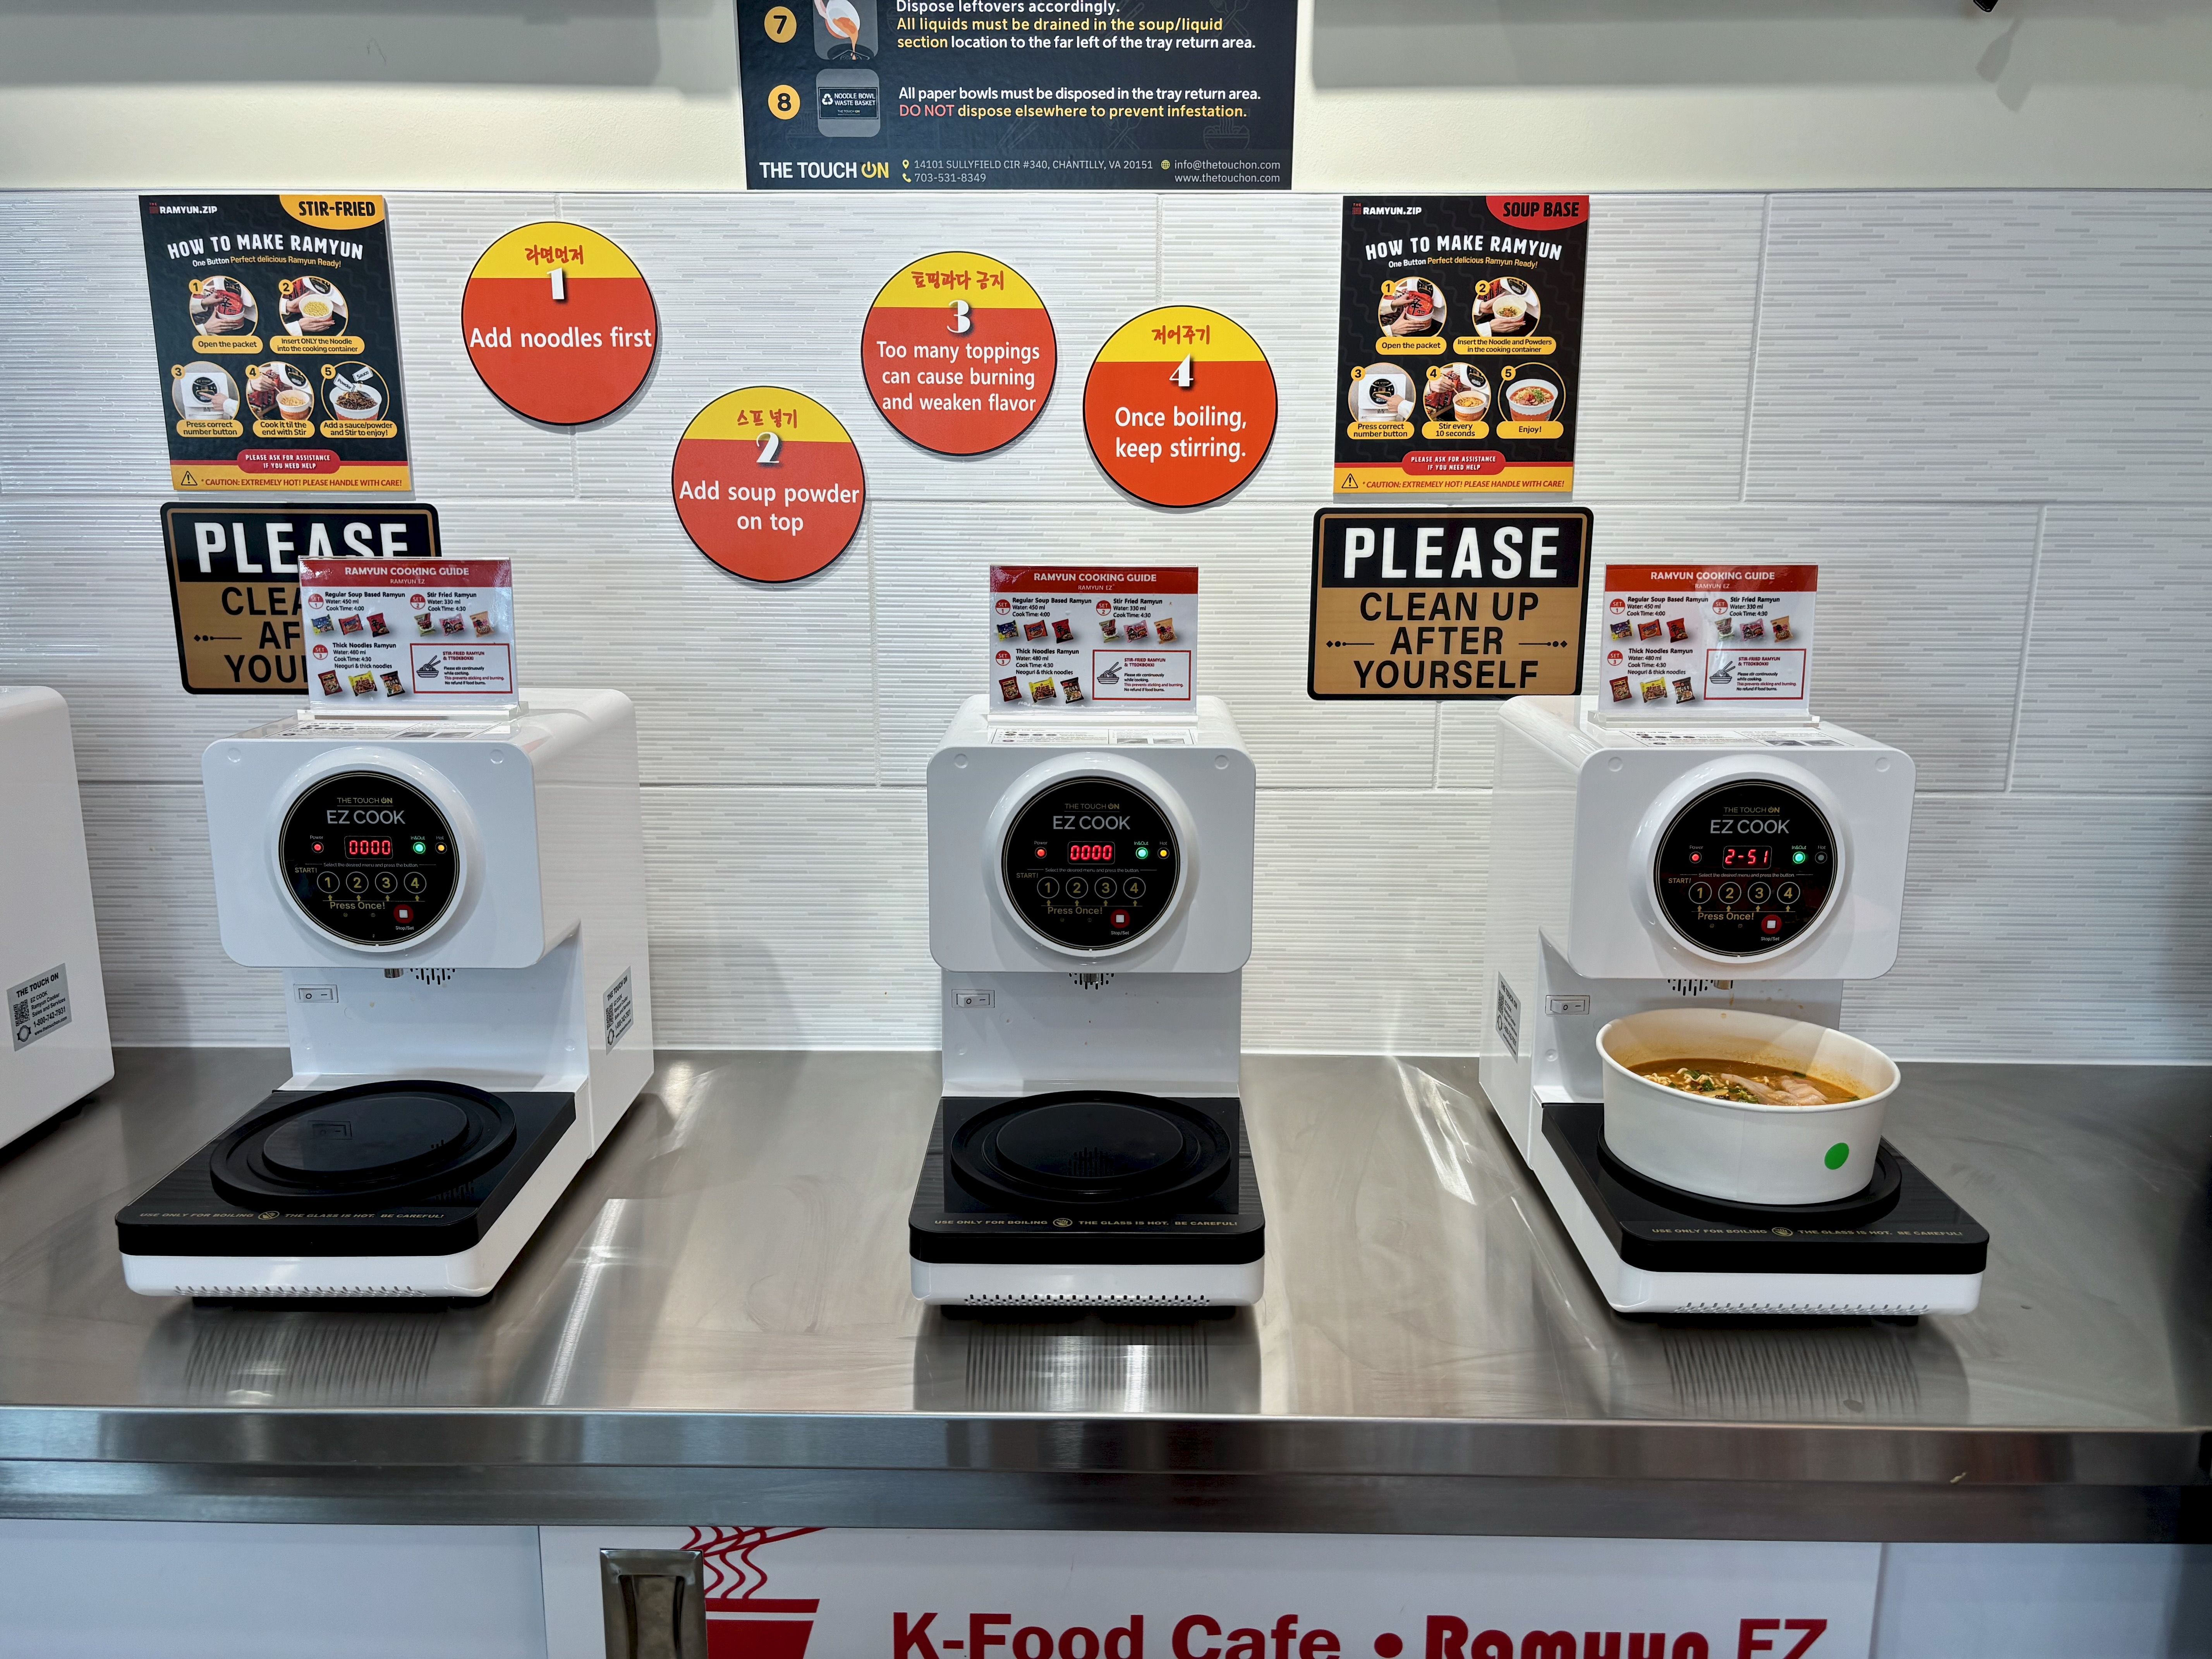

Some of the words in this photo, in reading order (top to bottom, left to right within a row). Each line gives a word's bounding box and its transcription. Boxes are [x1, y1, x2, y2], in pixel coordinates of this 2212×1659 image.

[896, 0, 954, 15] Dispose
[959, 0, 1024, 12] leftovers
[1029, 0, 1120, 15] accordingly.
[773, 15, 787, 34] 7
[897, 17, 915, 30] All
[920, 17, 968, 33] liquids
[972, 19, 1008, 30] must
[1012, 17, 1029, 30] be
[1034, 18, 1089, 30] drained
[1094, 18, 1106, 30] in
[1110, 18, 1135, 30] the
[1139, 17, 1222, 33] soup/liquid
[898, 35, 948, 48] section
[951, 35, 1007, 48] location
[1010, 36, 1025, 48] to
[1028, 36, 1051, 48] the
[1054, 36, 1073, 48] far
[1077, 36, 1100, 48] left
[1103, 36, 1118, 48] of
[1120, 36, 1142, 48] the
[1145, 36, 1173, 52] tray
[1176, 36, 1219, 48] return
[1221, 38, 1256, 49] area.
[777, 93, 792, 112] 8
[900, 104, 921, 116] DO
[925, 105, 955, 117] NOT
[958, 105, 1012, 119] dispose
[1015, 105, 1087, 117] elsewhere
[1090, 105, 1106, 117] to
[1109, 105, 1164, 120] prevent
[1168, 105, 1247, 117] infestation.
[759, 162, 793, 178] THE
[797, 162, 857, 179] TOUCH
[914, 160, 944, 169] 14101
[946, 160, 1001, 169] SULLYFIELD
[1003, 160, 1020, 169] CIR
[1022, 160, 1050, 170] #340,
[1052, 160, 1106, 170] CHANTILLY,
[1108, 160, 1121, 169] VA
[1123, 160, 1153, 169] 20151
[1175, 160, 1280, 170] info@thetouchon.com
[914, 173, 986, 183] 703-531-8349
[1174, 172, 1280, 183] www.thetouchon.com
[159, 205, 218, 214] RAMYUN.ZIP
[299, 201, 375, 216] STIR-FRIED
[1363, 206, 1422, 215] RAMYUN.ZIP
[1503, 202, 1540, 217] SOUP
[1543, 202, 1580, 217] BASE
[167, 238, 204, 259] HOW
[210, 235, 231, 252] TO
[237, 234, 283, 250] MAKE
[290, 235, 363, 260] RAMYUN
[524, 244, 584, 266] 라면먼저
[1365, 239, 1403, 261] HOW
[1410, 237, 1430, 253] TO
[1437, 235, 1484, 251] MAKE
[1490, 236, 1562, 261] RAMYUN
[548, 268, 564, 299] 1
[976, 270, 1004, 290] 금지
[947, 300, 970, 333] 3
[470, 327, 512, 348] Add
[521, 326, 602, 347] noodles
[610, 326, 652, 347] first
[1151, 325, 1210, 345] 저어주기
[876, 341, 907, 358] Too
[914, 345, 959, 364] many
[965, 342, 1040, 364] toppings
[1381, 342, 1401, 350] Open
[1415, 342, 1441, 350] packet
[882, 371, 910, 384] can
[917, 372, 963, 385] cause
[970, 367, 1034, 390] burning
[1169, 355, 1194, 387] 4
[882, 392, 913, 410] and
[919, 393, 981, 410] weaken
[988, 393, 1036, 411] flavor
[737, 410, 764, 426] 스프
[769, 408, 797, 429] 넣기
[1115, 407, 1165, 427] Once
[1174, 405, 1246, 432] boiling,
[1518, 425, 1542, 434] Enjoy!
[756, 432, 780, 463] 2
[1116, 437, 1162, 463] keep
[1170, 436, 1246, 463] stirring.
[679, 480, 720, 500] Add
[728, 486, 776, 507] soup
[785, 483, 860, 507] powder
[737, 516, 762, 530] on
[769, 514, 804, 536] top
[1344, 526, 1559, 579] PLEASE
[1034, 573, 1076, 581] RAMYUN
[1078, 573, 1125, 582] COOKING
[1126, 573, 1157, 582] GUIDE
[1650, 572, 1694, 580] RAMYUN
[1696, 571, 1742, 580] COOKING
[1744, 572, 1775, 580] GUIDE
[1360, 592, 1477, 621] CLEAN
[1492, 592, 1539, 621] UP
[1390, 627, 1503, 654] AFTER
[1353, 660, 1538, 689] YOURSELF
[1710, 819, 1734, 834] EZ
[1737, 819, 1790, 834] COOK
[349, 840, 390, 855] 0000
[1070, 845, 1112, 860] 0000
[1697, 912, 1724, 921] Press
[1726, 912, 1754, 921] Once!
[16, 987, 29, 998] THE
[29, 977, 49, 991] TOUCH
